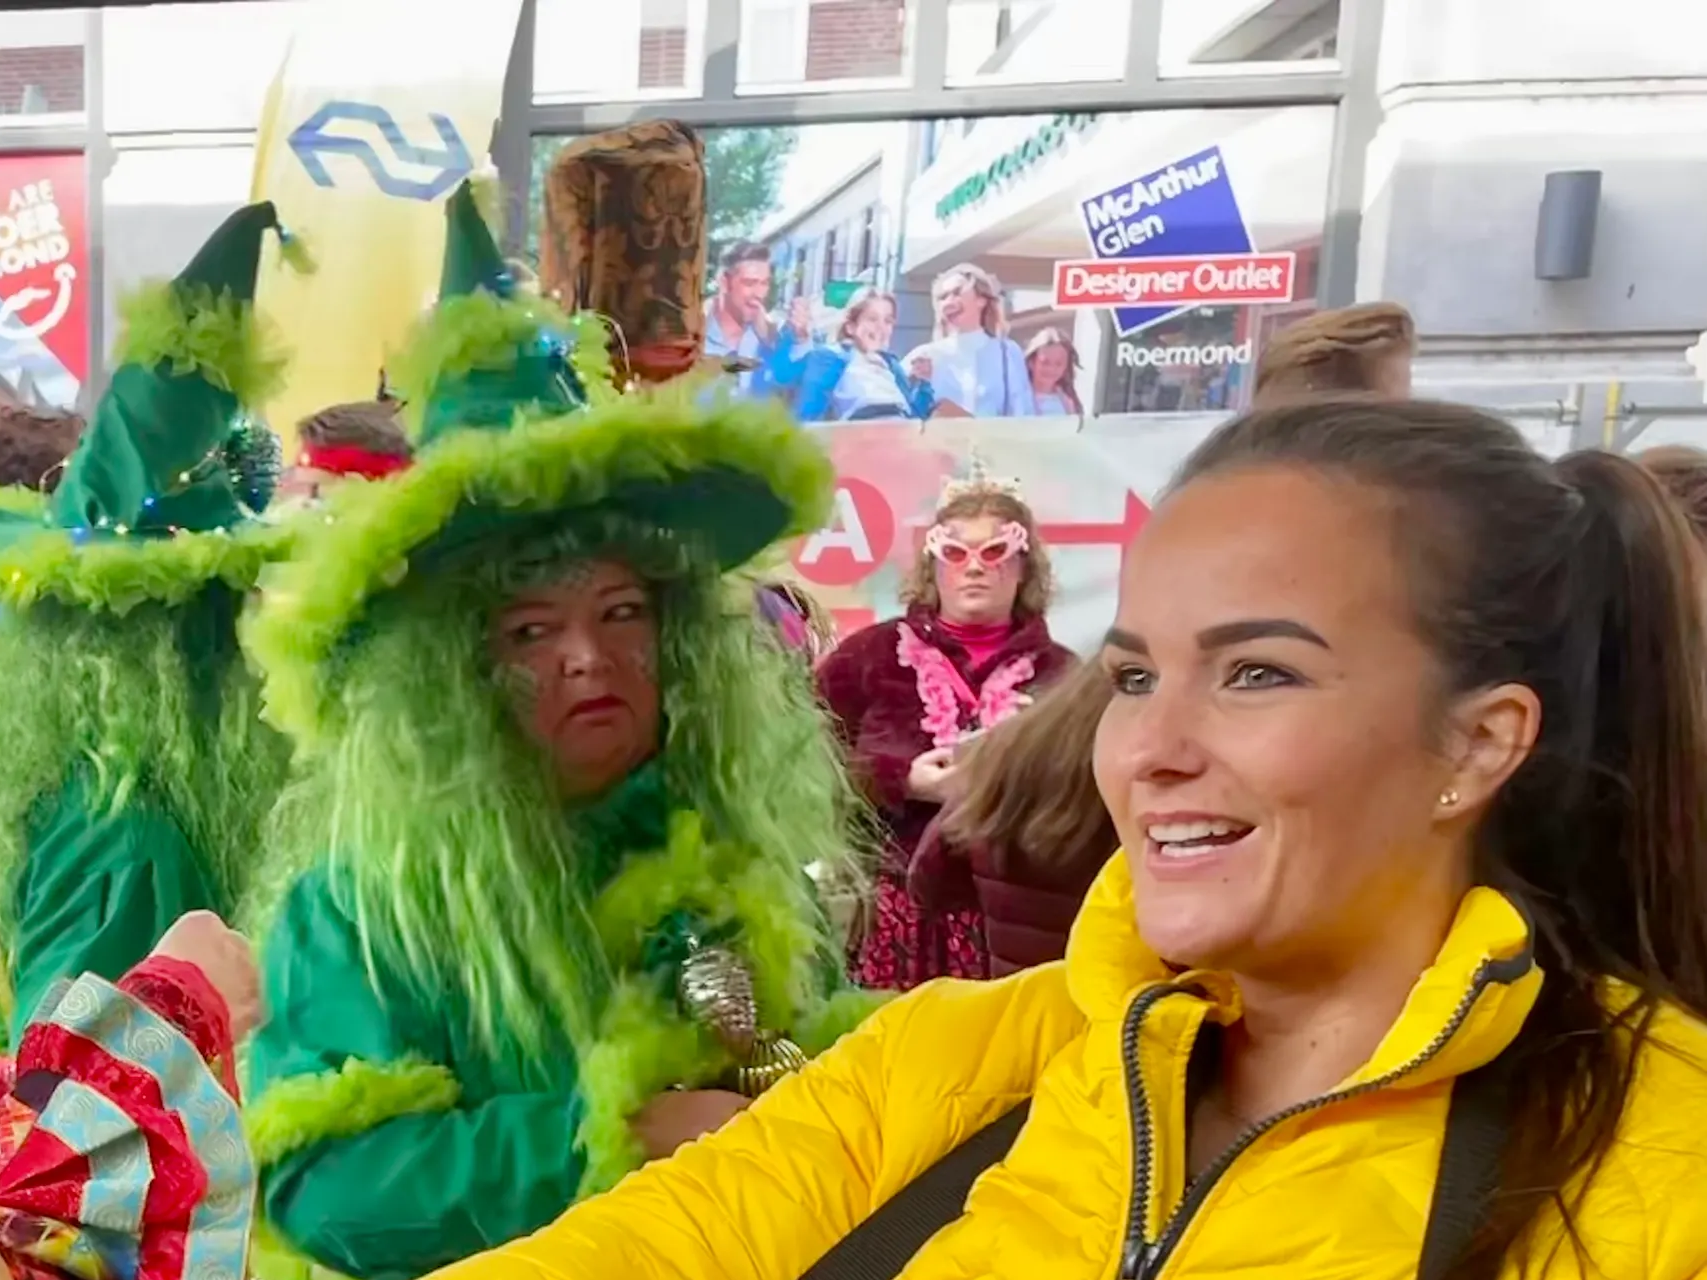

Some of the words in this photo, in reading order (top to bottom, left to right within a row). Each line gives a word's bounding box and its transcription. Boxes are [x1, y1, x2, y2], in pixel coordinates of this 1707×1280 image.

[9, 179, 54, 211] ARE
[1087, 155, 1219, 229] McArthur
[1096, 214, 1165, 256] Glen
[1065, 267, 1190, 301] Designer
[1193, 261, 1283, 291] Outlet
[1117, 338, 1253, 367] Roermond
[798, 487, 875, 564] A
